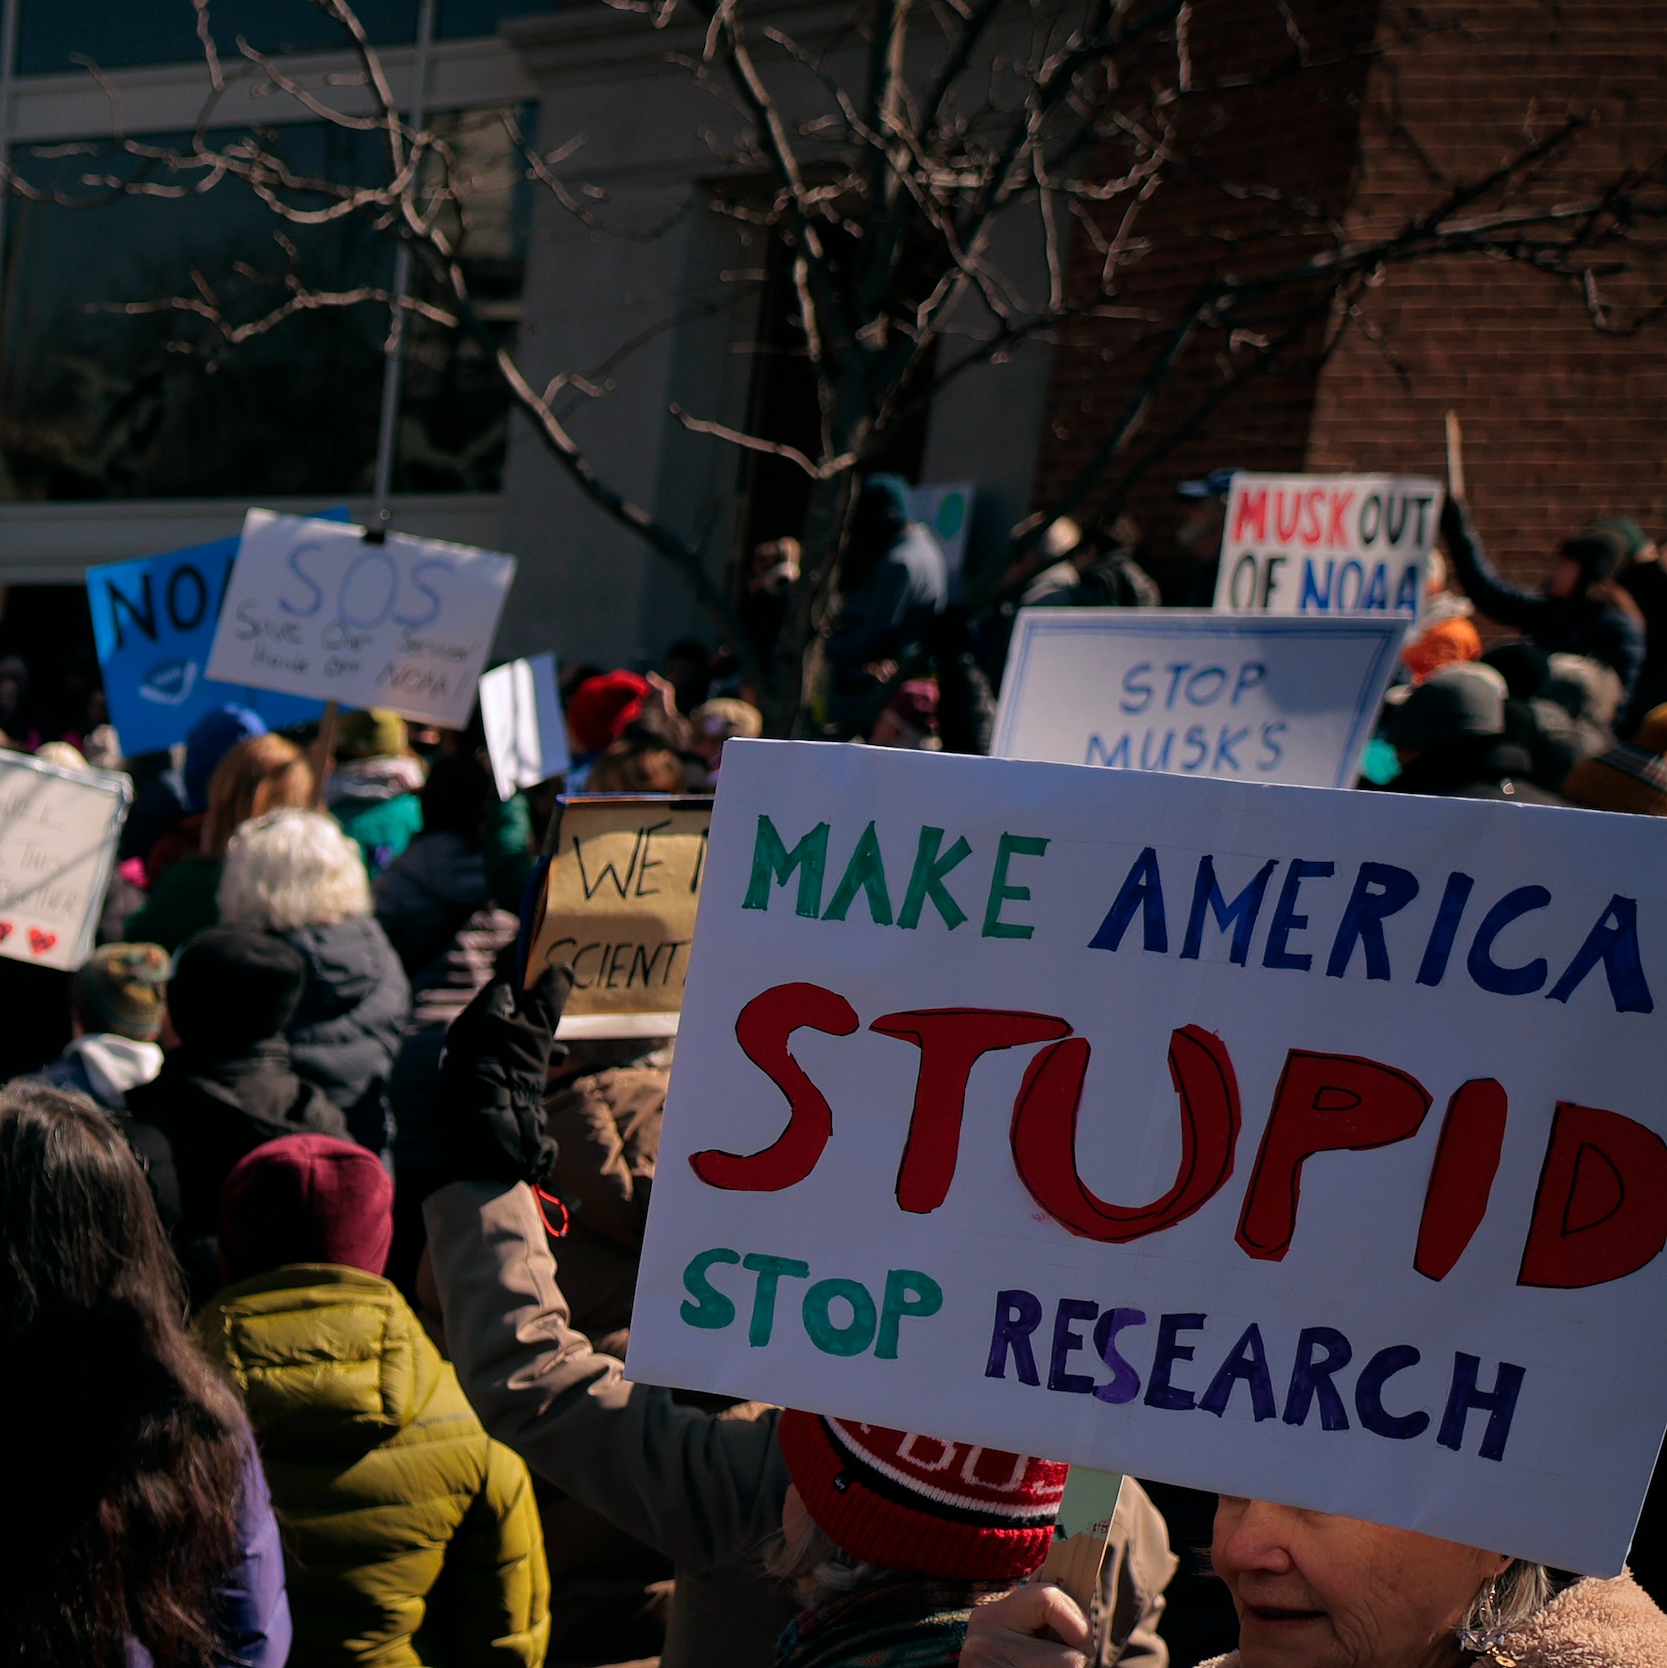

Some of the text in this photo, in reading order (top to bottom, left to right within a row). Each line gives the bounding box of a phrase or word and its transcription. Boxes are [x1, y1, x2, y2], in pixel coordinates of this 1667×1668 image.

[1234, 489, 1433, 548] MUSK OUT
[105, 556, 234, 648] NO
[279, 541, 455, 628] SOS
[1230, 555, 1418, 616] OF NOAA
[1119, 661, 1265, 715] STOP
[573, 819, 672, 901] WE
[741, 814, 1052, 939] MAKE
[1087, 846, 1654, 1013] AMERICA
[545, 936, 691, 989] SCIENT
[687, 981, 1667, 1290] STUPID
[679, 1247, 944, 1360] STOP
[985, 1289, 1525, 1462] RESEARCH
